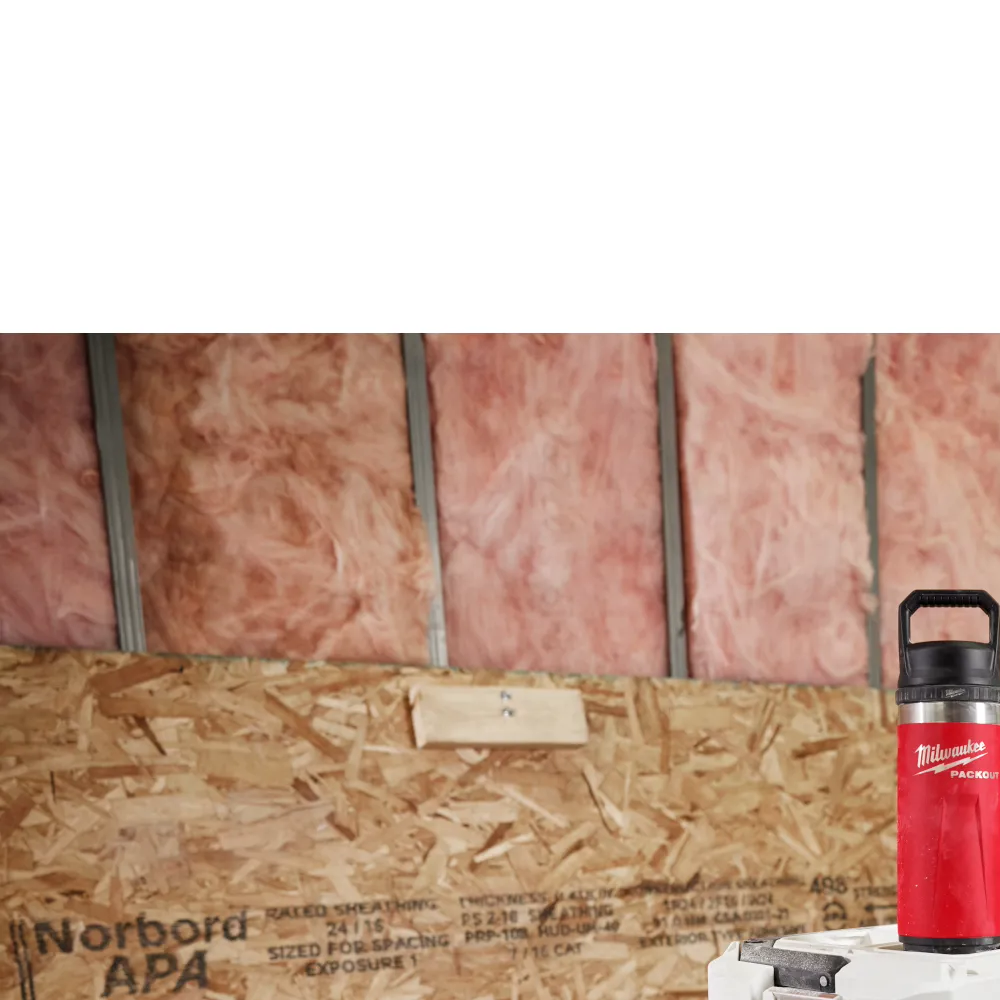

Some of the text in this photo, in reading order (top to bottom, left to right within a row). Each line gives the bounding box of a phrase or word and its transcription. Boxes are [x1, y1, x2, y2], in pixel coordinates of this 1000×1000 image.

[915, 739, 986, 768] Milwaukee
[950, 770, 999, 780] PACKOUT
[34, 909, 248, 955] Norbord
[267, 934, 450, 961] SIZED FOR SPACING
[101, 949, 208, 998] APA
[305, 954, 403, 977] EXPOSURE
